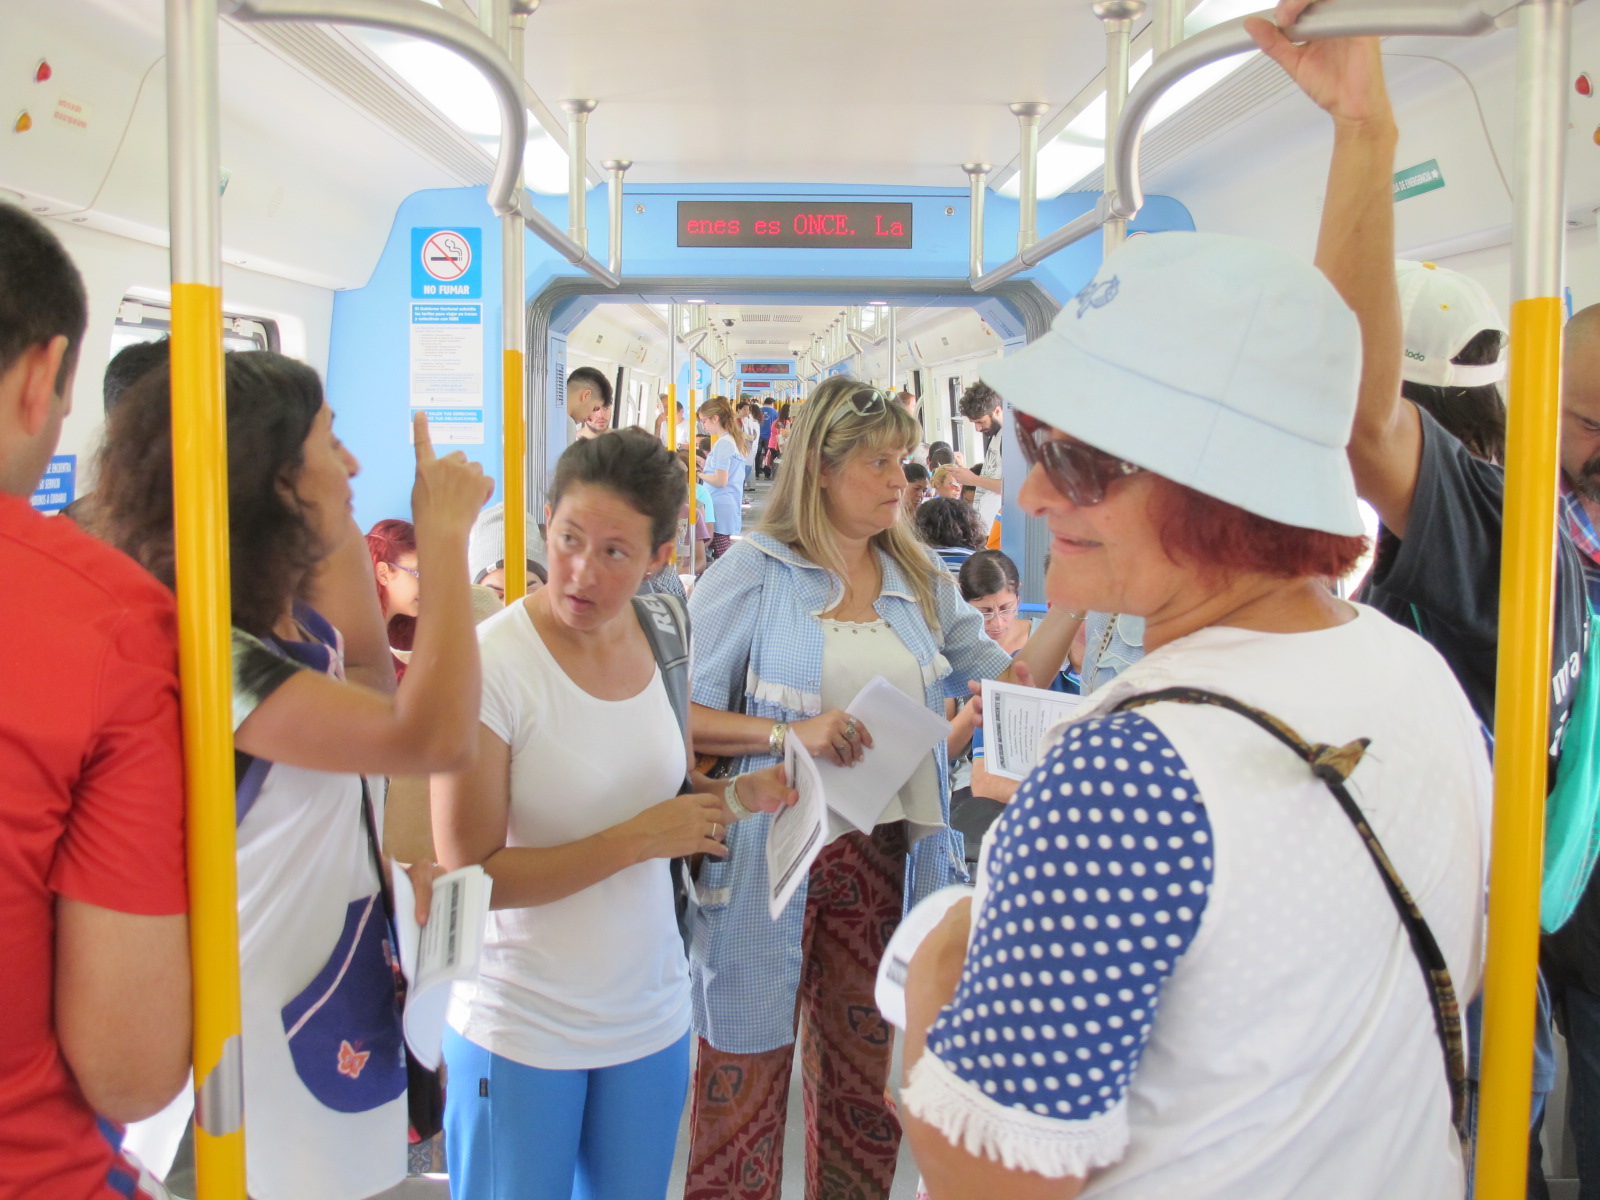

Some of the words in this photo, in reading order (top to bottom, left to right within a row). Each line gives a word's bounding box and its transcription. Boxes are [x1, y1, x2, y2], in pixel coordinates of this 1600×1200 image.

[686, 218, 741, 235] enes
[754, 219, 782, 235] es
[793, 214, 857, 236] ONCE.
[875, 214, 904, 236] La
[423, 285, 437, 295] NO
[438, 285, 470, 295] FUMAR
